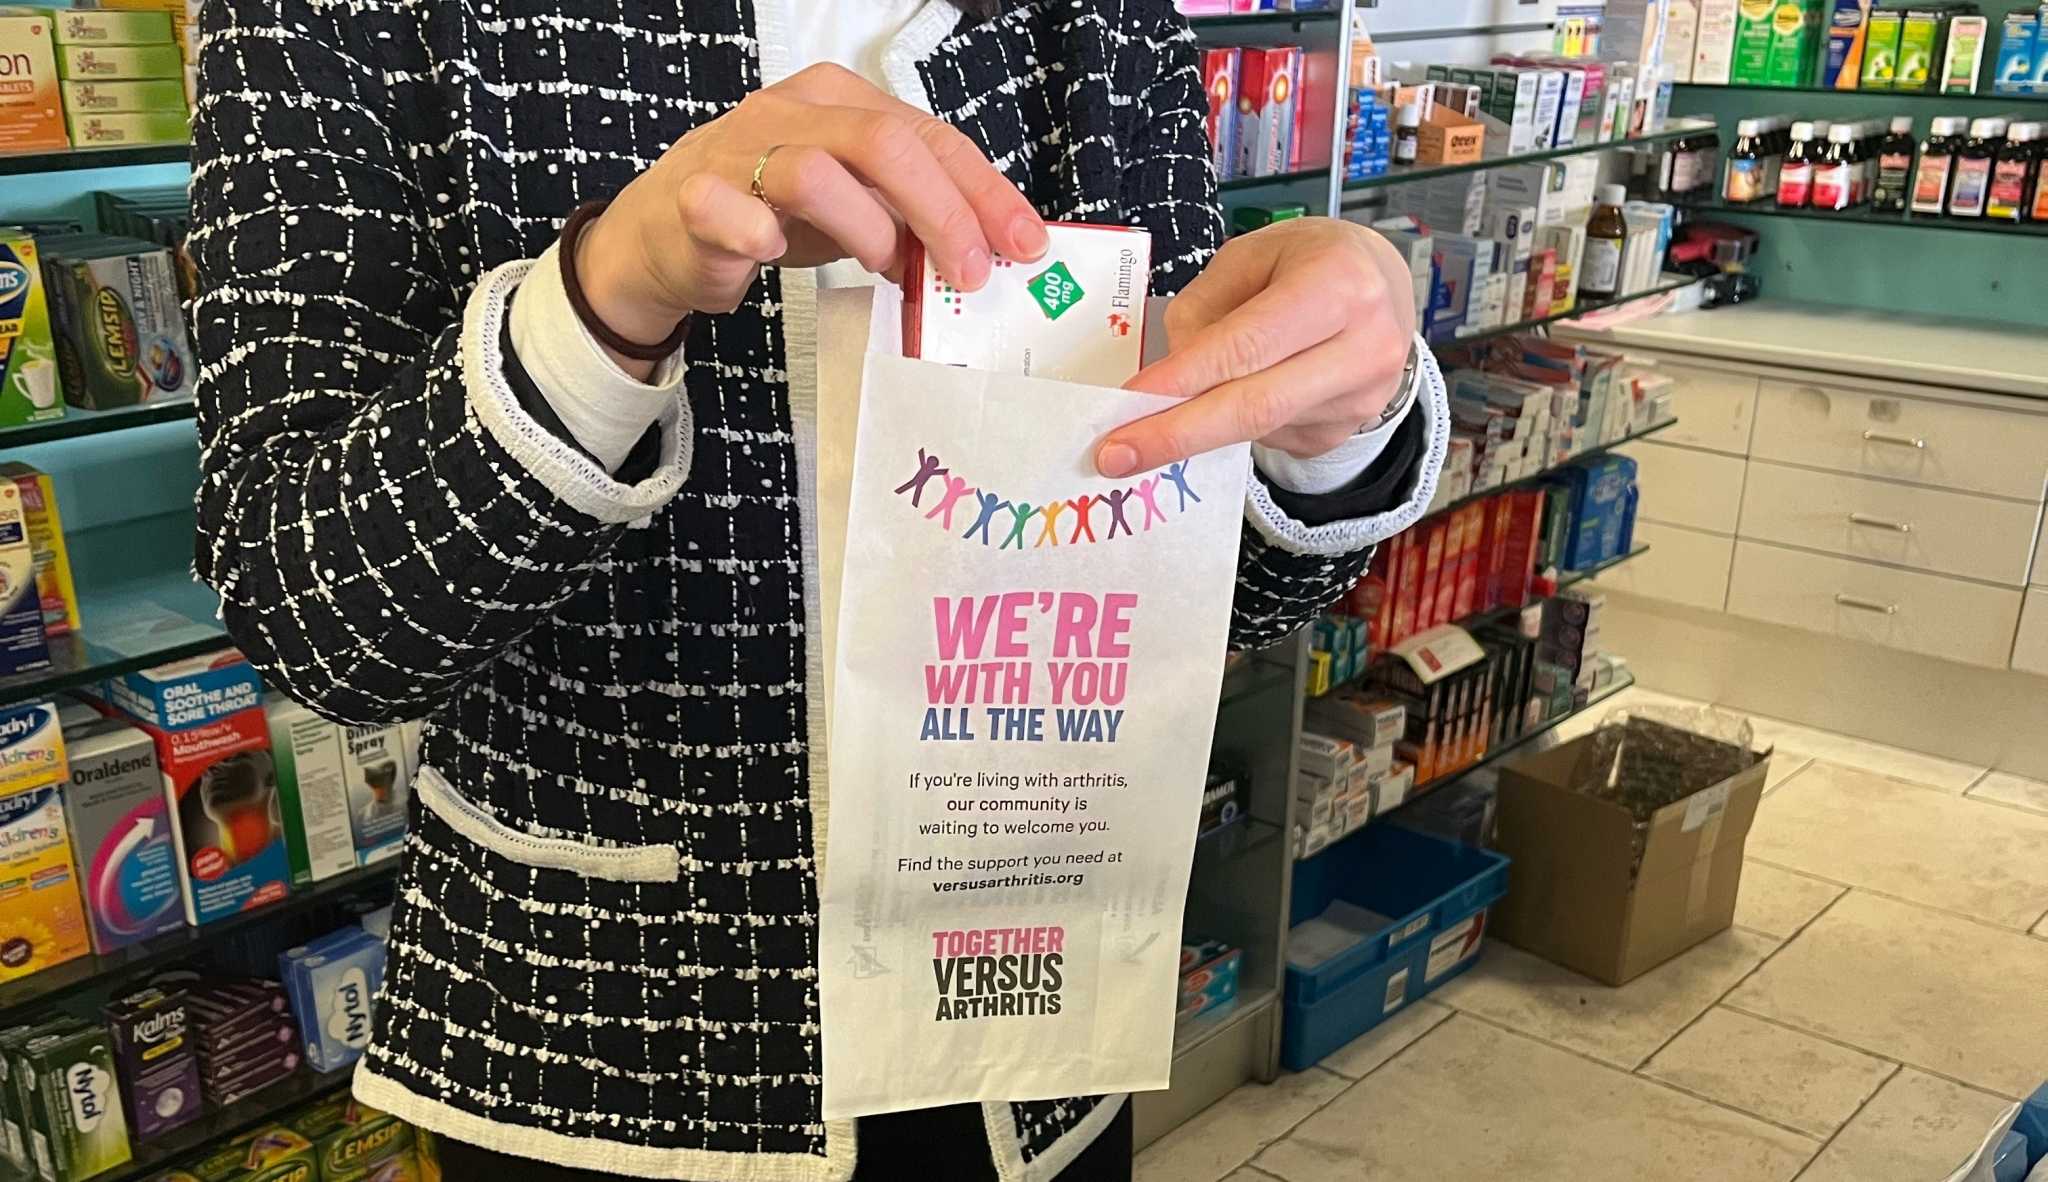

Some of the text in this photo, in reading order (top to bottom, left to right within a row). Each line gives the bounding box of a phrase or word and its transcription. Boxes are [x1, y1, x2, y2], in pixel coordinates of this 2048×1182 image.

[1043, 272, 1062, 310] 400
[1063, 281, 1075, 304] mg
[1112, 249, 1137, 308] Flamingo
[100, 289, 128, 373] LEMSIP
[933, 592, 1138, 662] WE'RE
[163, 682, 201, 700] ORAL
[165, 689, 222, 712] SOOTHE
[225, 682, 252, 701] AND
[925, 662, 1128, 706] WITH YOU
[167, 692, 257, 726] SORE THROAT
[920, 708, 1124, 742] ALL THE WAY
[348, 735, 385, 756] Spray
[72, 753, 151, 786] Oraldene
[909, 772, 1128, 791] If you're living with arthritis,
[947, 797, 1087, 813] our community is
[919, 819, 1110, 838] waiting to welcome you.
[898, 850, 1122, 872] Find the support you need at
[933, 872, 1083, 892] versusarthritis.org
[932, 926, 1064, 958] TOGETHER
[933, 953, 1063, 998] VERSUS
[935, 991, 1062, 1021] ARTHRITIS
[133, 1006, 185, 1043] Kalms
[334, 1121, 402, 1165] LEMSIP
